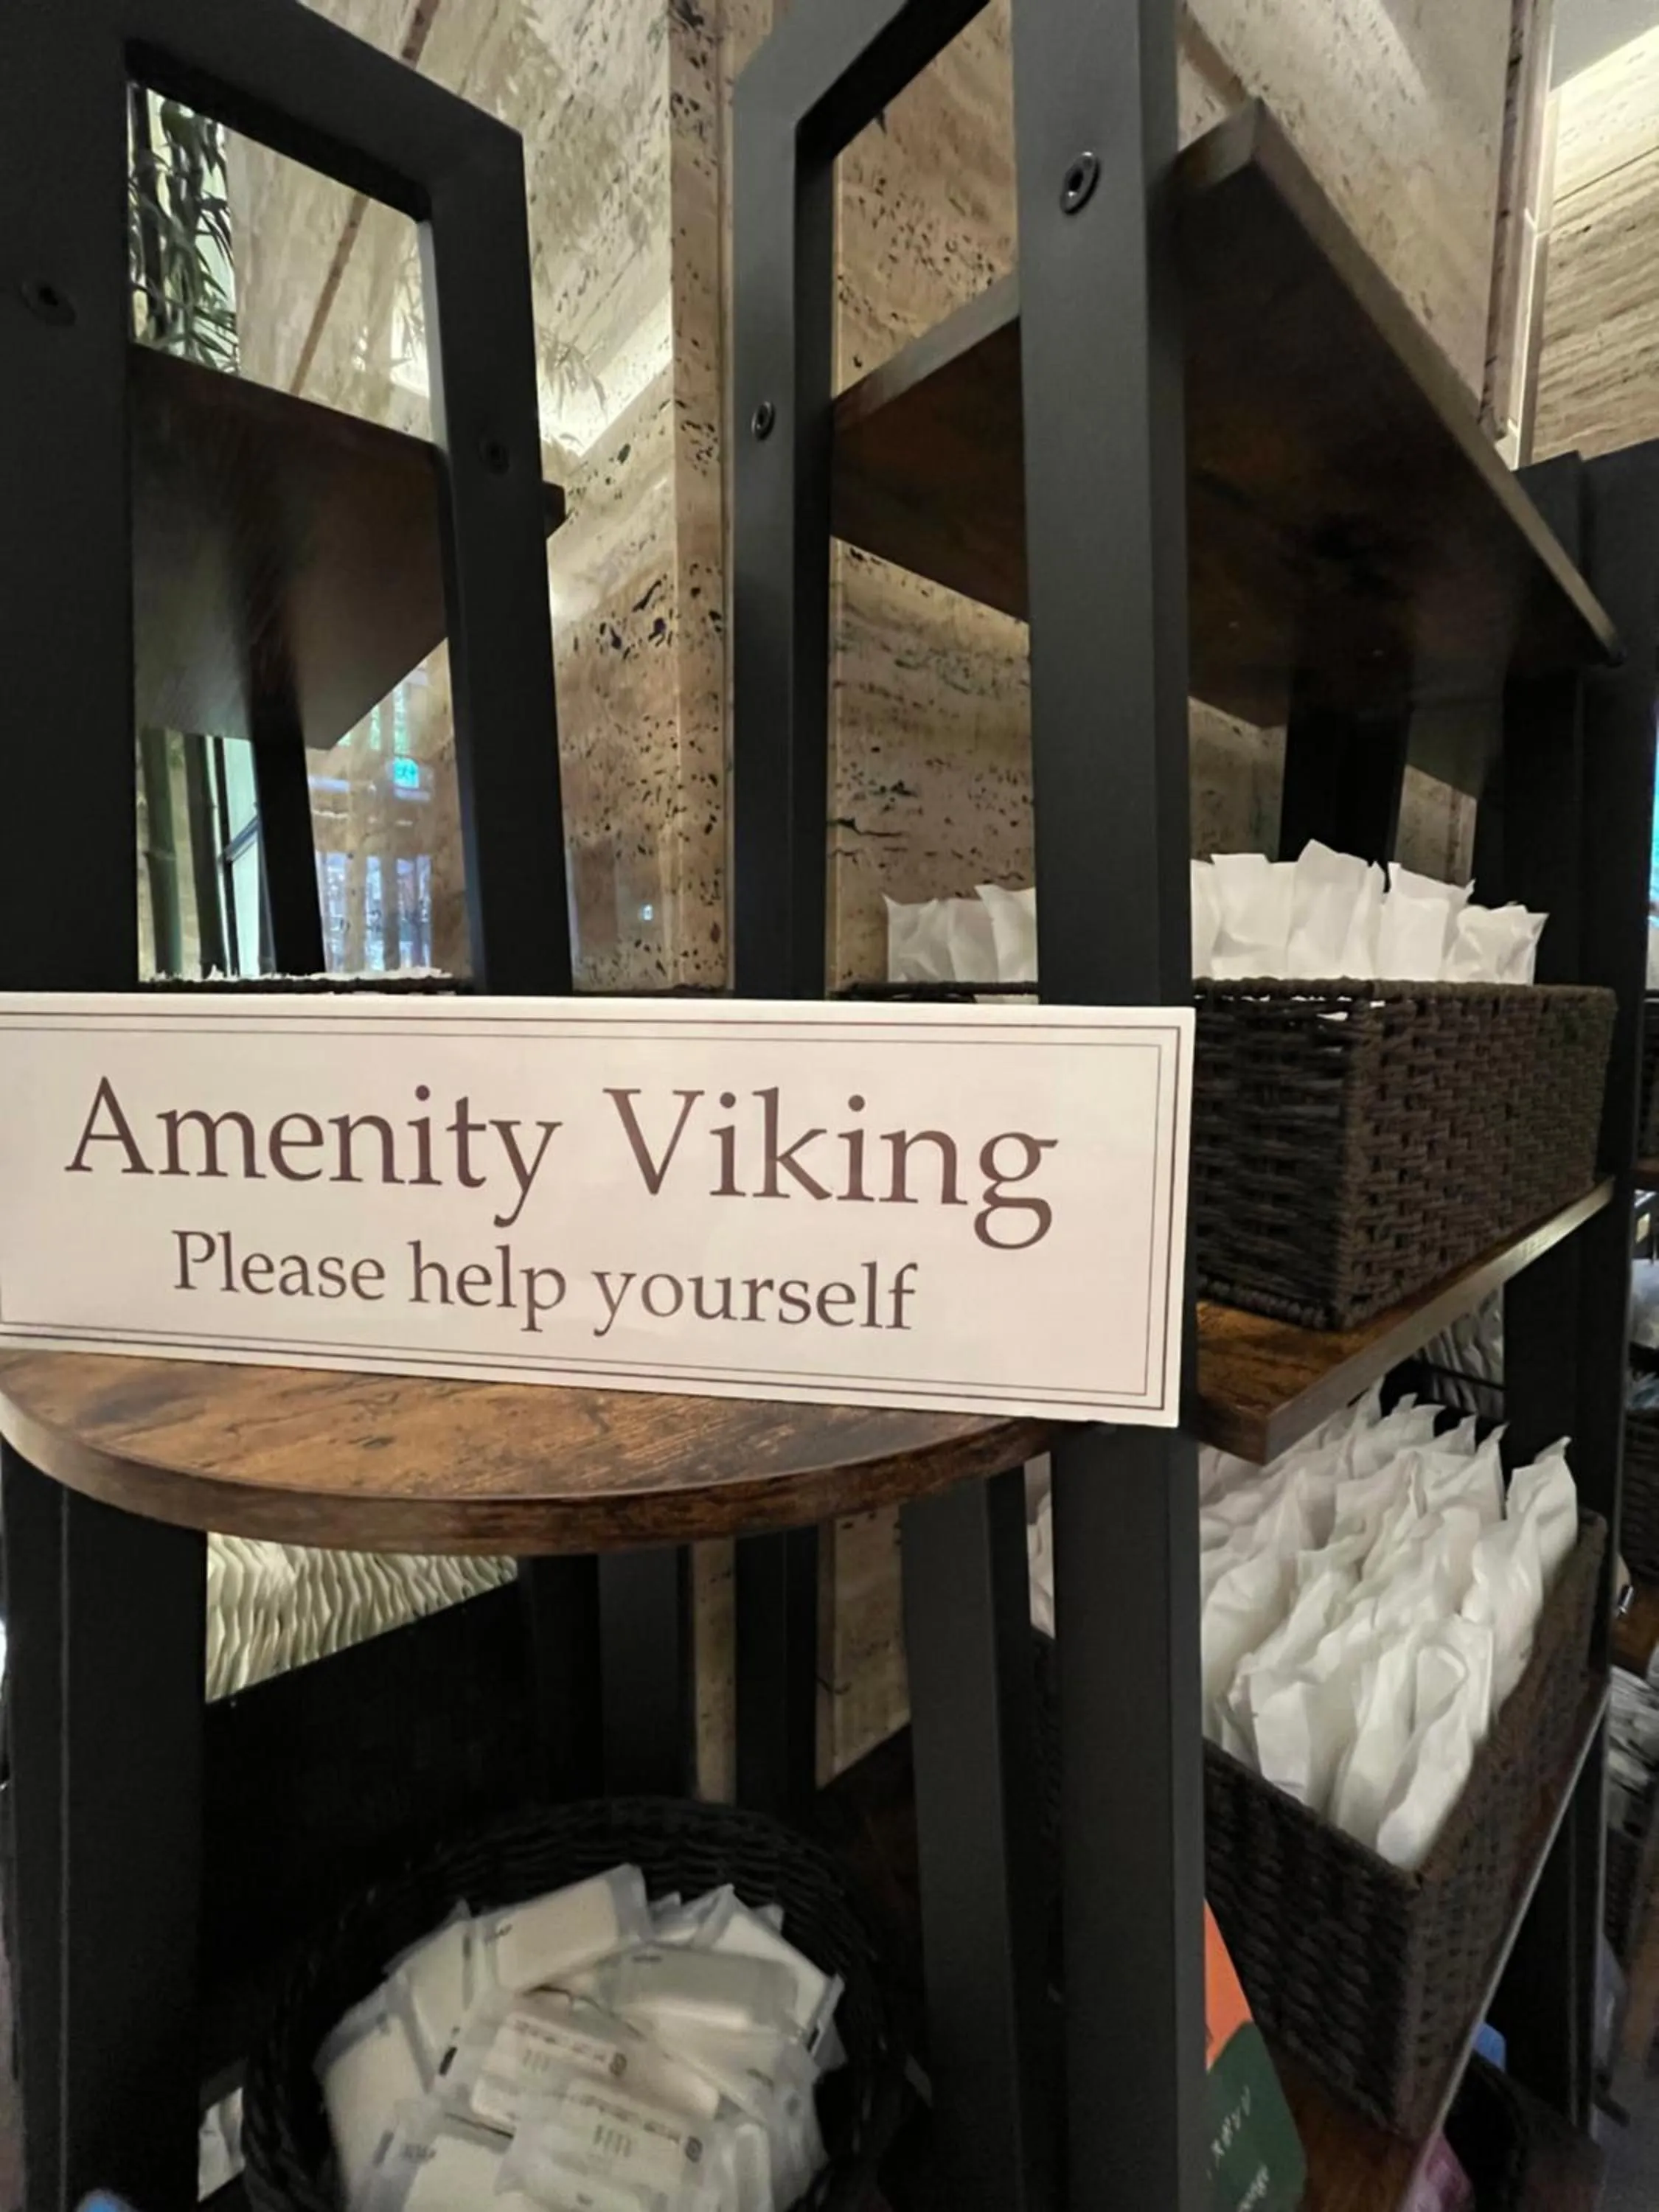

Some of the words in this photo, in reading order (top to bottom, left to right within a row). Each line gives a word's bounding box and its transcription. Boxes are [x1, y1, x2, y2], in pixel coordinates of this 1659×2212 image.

[65, 1076, 562, 1228] Amenity
[603, 1087, 1058, 1249] Viking
[171, 1230, 386, 1301] Please
[408, 1240, 566, 1332] help
[592, 1262, 917, 1337] yourself
